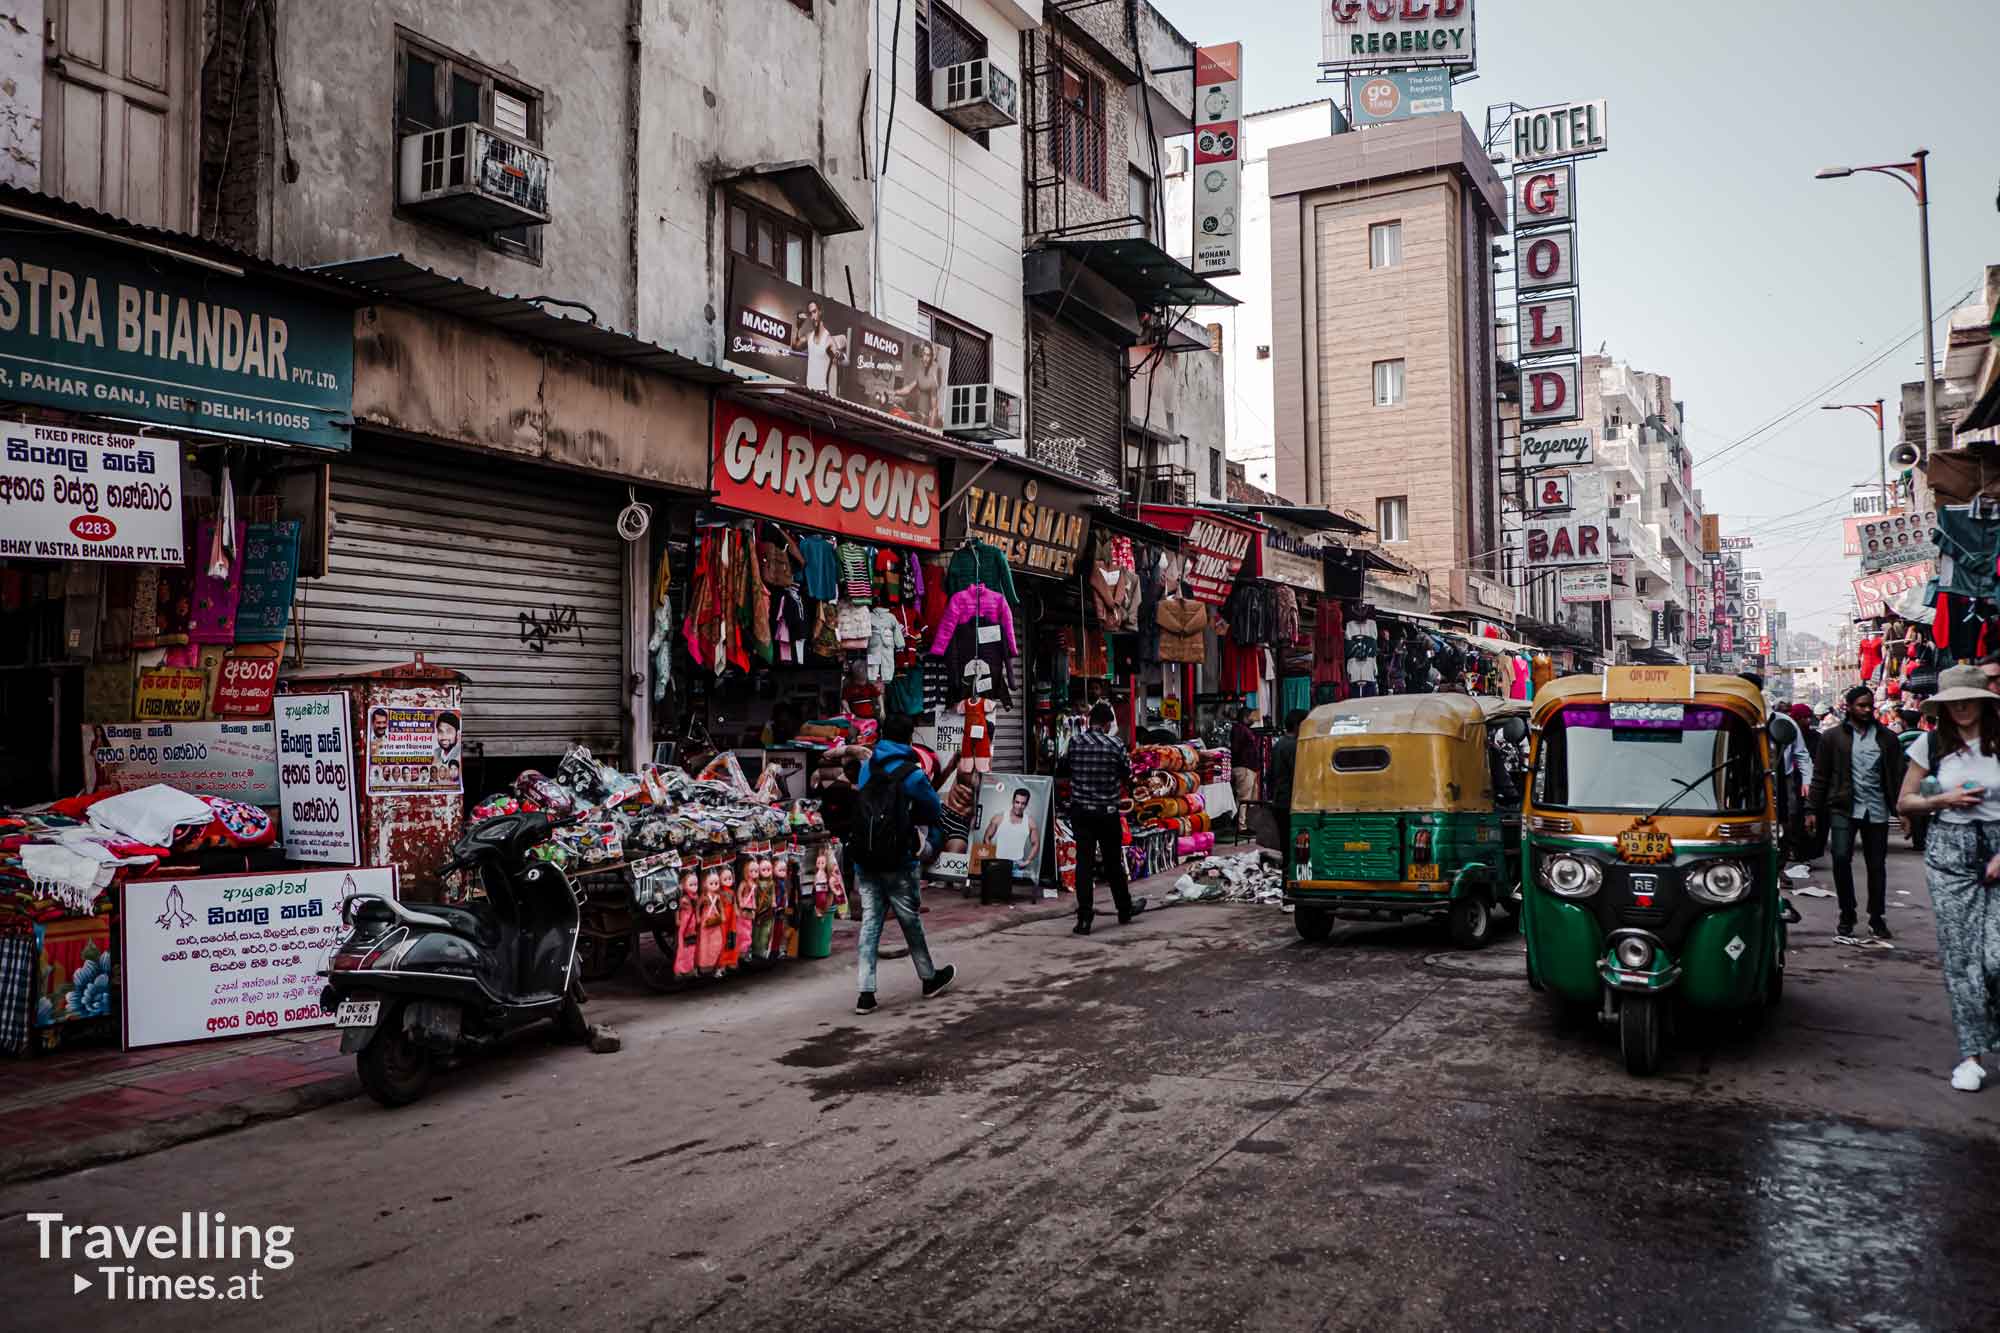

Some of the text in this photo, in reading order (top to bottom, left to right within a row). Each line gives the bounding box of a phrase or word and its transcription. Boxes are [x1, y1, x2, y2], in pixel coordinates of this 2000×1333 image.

[1350, 28, 1465, 55] REGENCY
[1514, 104, 1602, 156] HOTEL
[1205, 257, 1226, 267] TIMES
[1523, 173, 1566, 413] GOLD
[117, 283, 288, 382] BHANDAR
[292, 366, 315, 387] PVT.
[316, 370, 339, 391] LTD.
[742, 311, 786, 339] MACHO
[864, 332, 899, 356] MACHO
[20, 370, 88, 398] PAHAR
[94, 383, 150, 409] GANJ,
[200, 400, 311, 431] DELHI-110055
[34, 427, 136, 450] FIXED PRICE SHOP
[1522, 431, 1589, 464] Regency
[723, 416, 936, 528] GARGSONS
[1541, 481, 1564, 504] &
[76, 521, 111, 536] 4283
[968, 486, 1084, 550] TALISMAN
[34, 541, 79, 557] VASTRA
[82, 543, 135, 559] BHANDAR
[137, 546, 158, 561] PVT.
[161, 547, 182, 562] LTD.
[1527, 524, 1601, 562] BAR
[1195, 553, 1230, 582] TIMES
[1631, 669, 1669, 681] ON DUTY
[937, 734, 953, 743] FITS
[1296, 860, 1313, 881] CNG
[1634, 880, 1653, 891] RE
[353, 1014, 372, 1024] 7491
